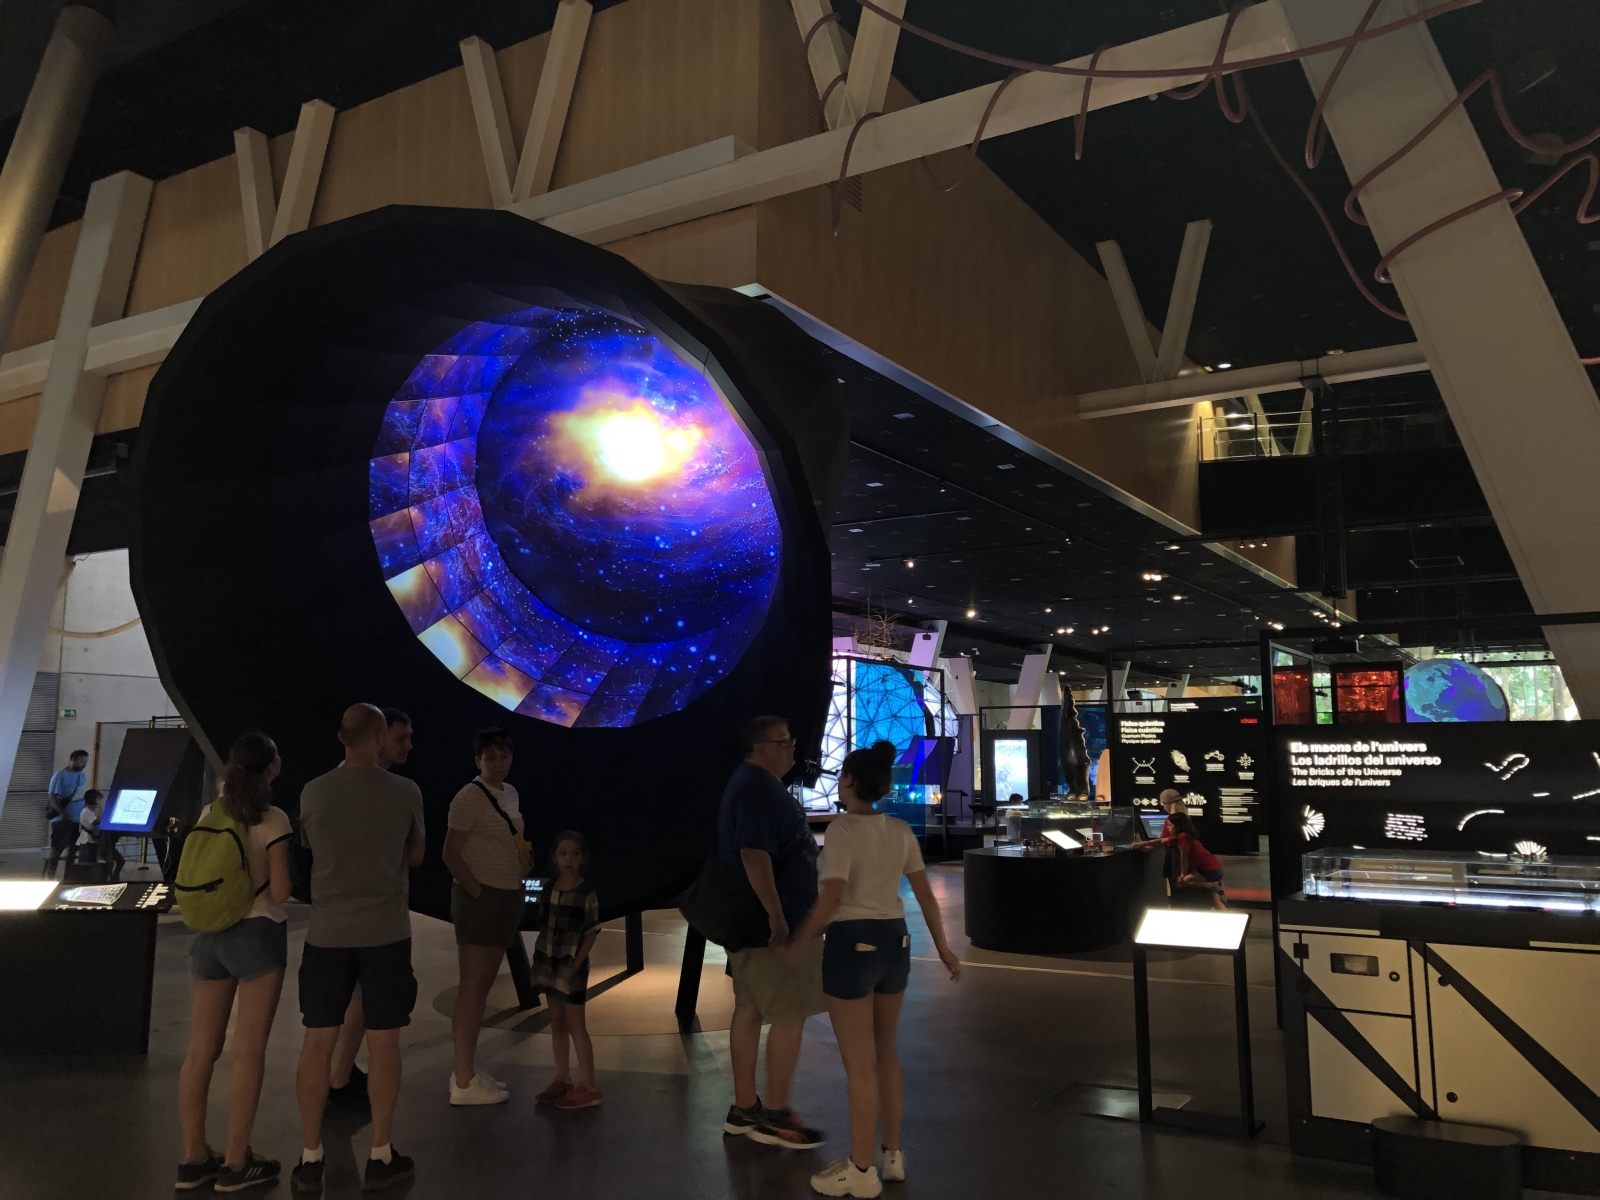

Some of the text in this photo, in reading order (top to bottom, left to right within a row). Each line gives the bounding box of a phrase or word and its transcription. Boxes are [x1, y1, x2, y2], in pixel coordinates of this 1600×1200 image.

[1290, 741, 1309, 753] Els
[1310, 743, 1352, 753] maons
[1353, 741, 1370, 753] de
[1291, 754, 1442, 766] Los ladrillos del universo
[1291, 767, 1402, 776] The Bricks of the Universe
[1292, 777, 1307, 786] Les
[1308, 777, 1340, 788] briques
[1341, 777, 1354, 786] de
